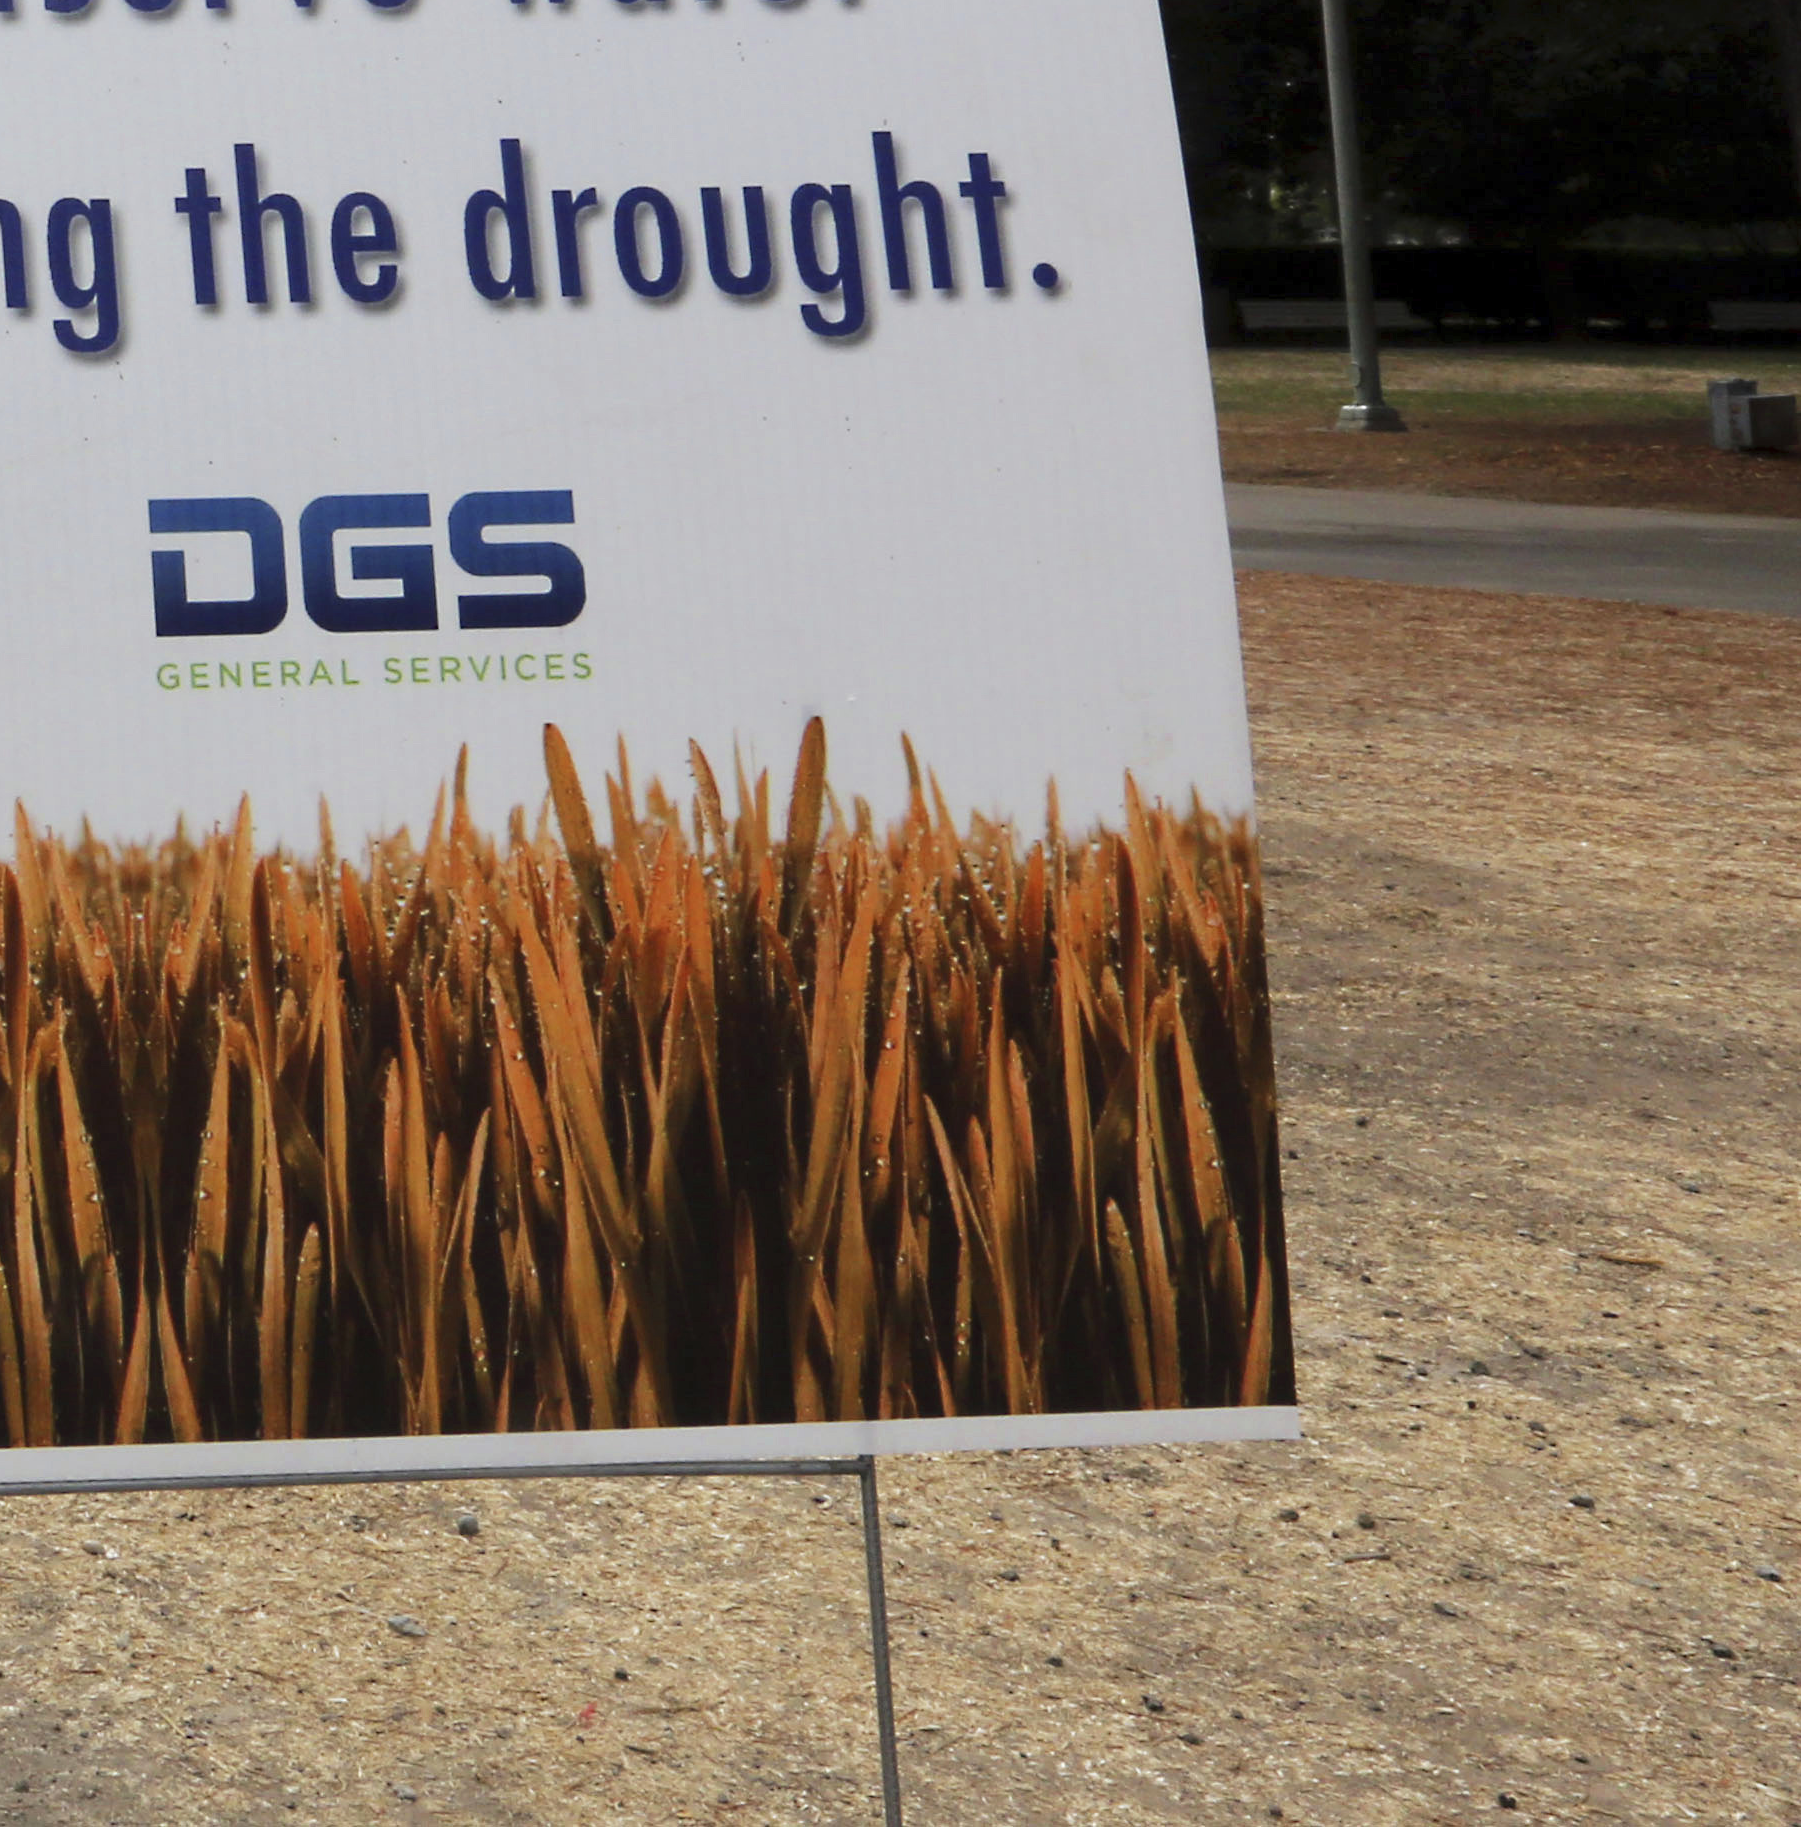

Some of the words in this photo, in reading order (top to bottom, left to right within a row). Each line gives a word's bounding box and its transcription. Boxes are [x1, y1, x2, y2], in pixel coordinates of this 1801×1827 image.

[173, 142, 399, 306] the
[462, 130, 1059, 339] drought.
[147, 488, 586, 636] DGS
[156, 659, 364, 692] GENERAL
[383, 651, 596, 687] SERVICES
